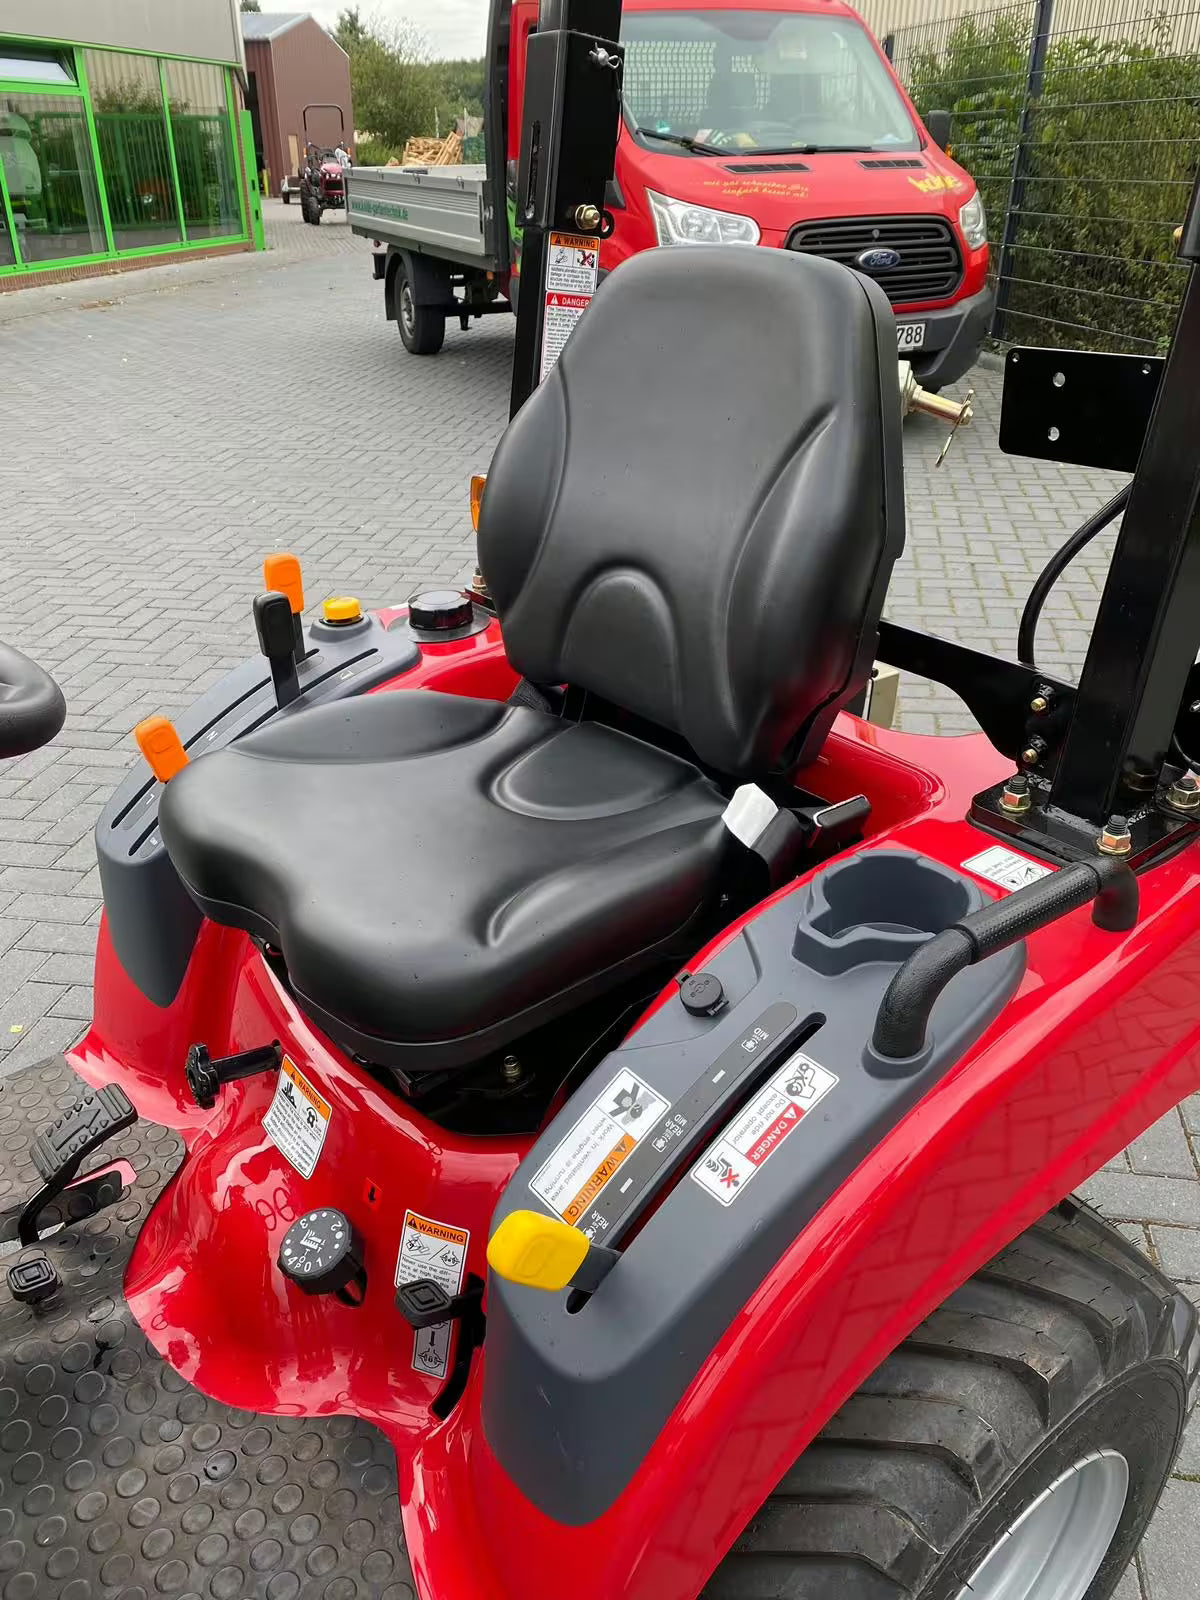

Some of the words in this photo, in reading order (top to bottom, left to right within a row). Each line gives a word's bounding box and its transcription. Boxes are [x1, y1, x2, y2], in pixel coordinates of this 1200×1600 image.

[564, 239, 596, 248] WARNING
[870, 252, 893, 265] Ford
[562, 297, 589, 307] DANGER
[897, 326, 923, 344] 788
[753, 1027, 769, 1041] MID
[298, 1079, 322, 1110] WARNING
[756, 1093, 778, 1117] except
[775, 1098, 786, 1108] Do
[674, 1114, 687, 1127] MID
[764, 1109, 777, 1122] not
[598, 1123, 615, 1141] Work
[664, 1119, 684, 1136] REAR
[732, 1116, 757, 1145] operator
[751, 1121, 765, 1136] ride
[572, 1135, 591, 1160] engine
[751, 1120, 788, 1161] DANGER
[551, 1184, 566, 1201] area
[568, 1156, 618, 1217] WARNING
[300, 1218, 308, 1229] 3
[330, 1220, 342, 1231] 2
[591, 1210, 610, 1230] REAR
[418, 1222, 464, 1242] WARNING
[287, 1256, 299, 1266] 4
[316, 1257, 323, 1267] 1
[429, 1265, 438, 1273] the
[433, 1273, 450, 1283] speed
